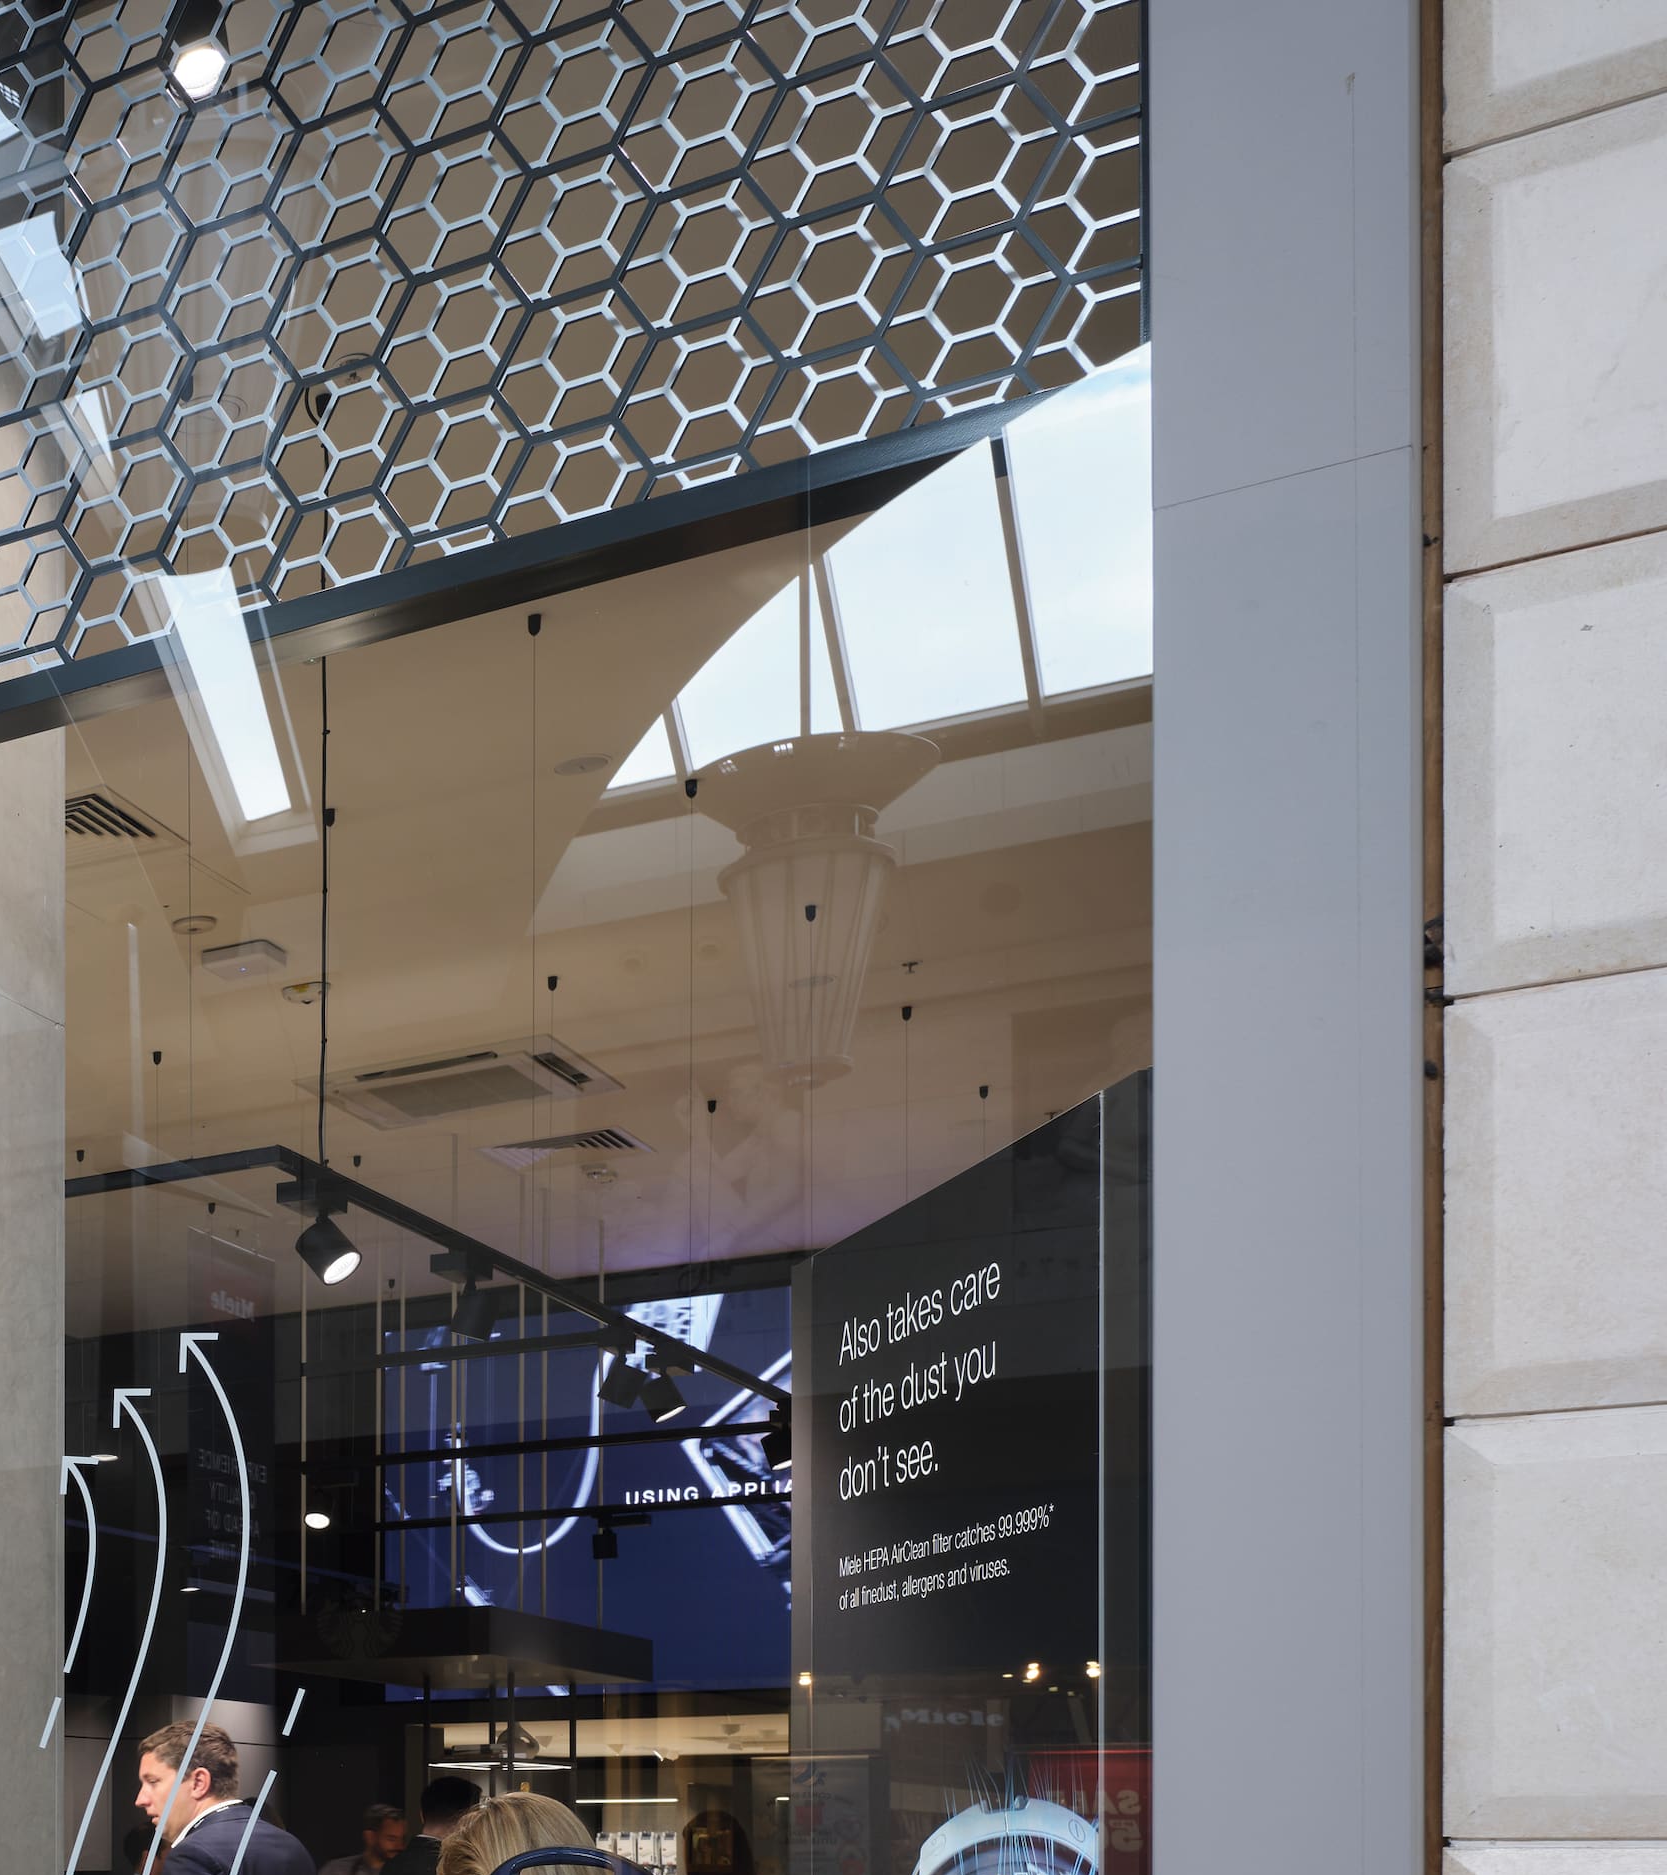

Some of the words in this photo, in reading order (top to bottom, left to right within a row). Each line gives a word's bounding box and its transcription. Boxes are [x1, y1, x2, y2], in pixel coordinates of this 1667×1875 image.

[839, 1316, 881, 1366] Also
[886, 1292, 943, 1344] takes
[950, 1262, 1000, 1316] care
[839, 1385, 858, 1433] of
[863, 1378, 895, 1424] the
[900, 1351, 948, 1410] dust
[954, 1340, 996, 1402] you
[625, 1485, 700, 1505] USING
[839, 1445, 890, 1501] don't
[895, 1440, 940, 1484] see.
[839, 1556, 862, 1578] Miele
[863, 1546, 890, 1573] HEPA
[890, 1538, 930, 1566] AirClean
[932, 1531, 952, 1555] filter
[954, 1522, 997, 1550] catches
[839, 1589, 849, 1611] of
[850, 1587, 860, 1610] all
[861, 1579, 900, 1606] finedust,
[901, 1571, 946, 1600] allergens
[947, 1563, 967, 1587] and
[969, 1556, 1011, 1583] viruses.
